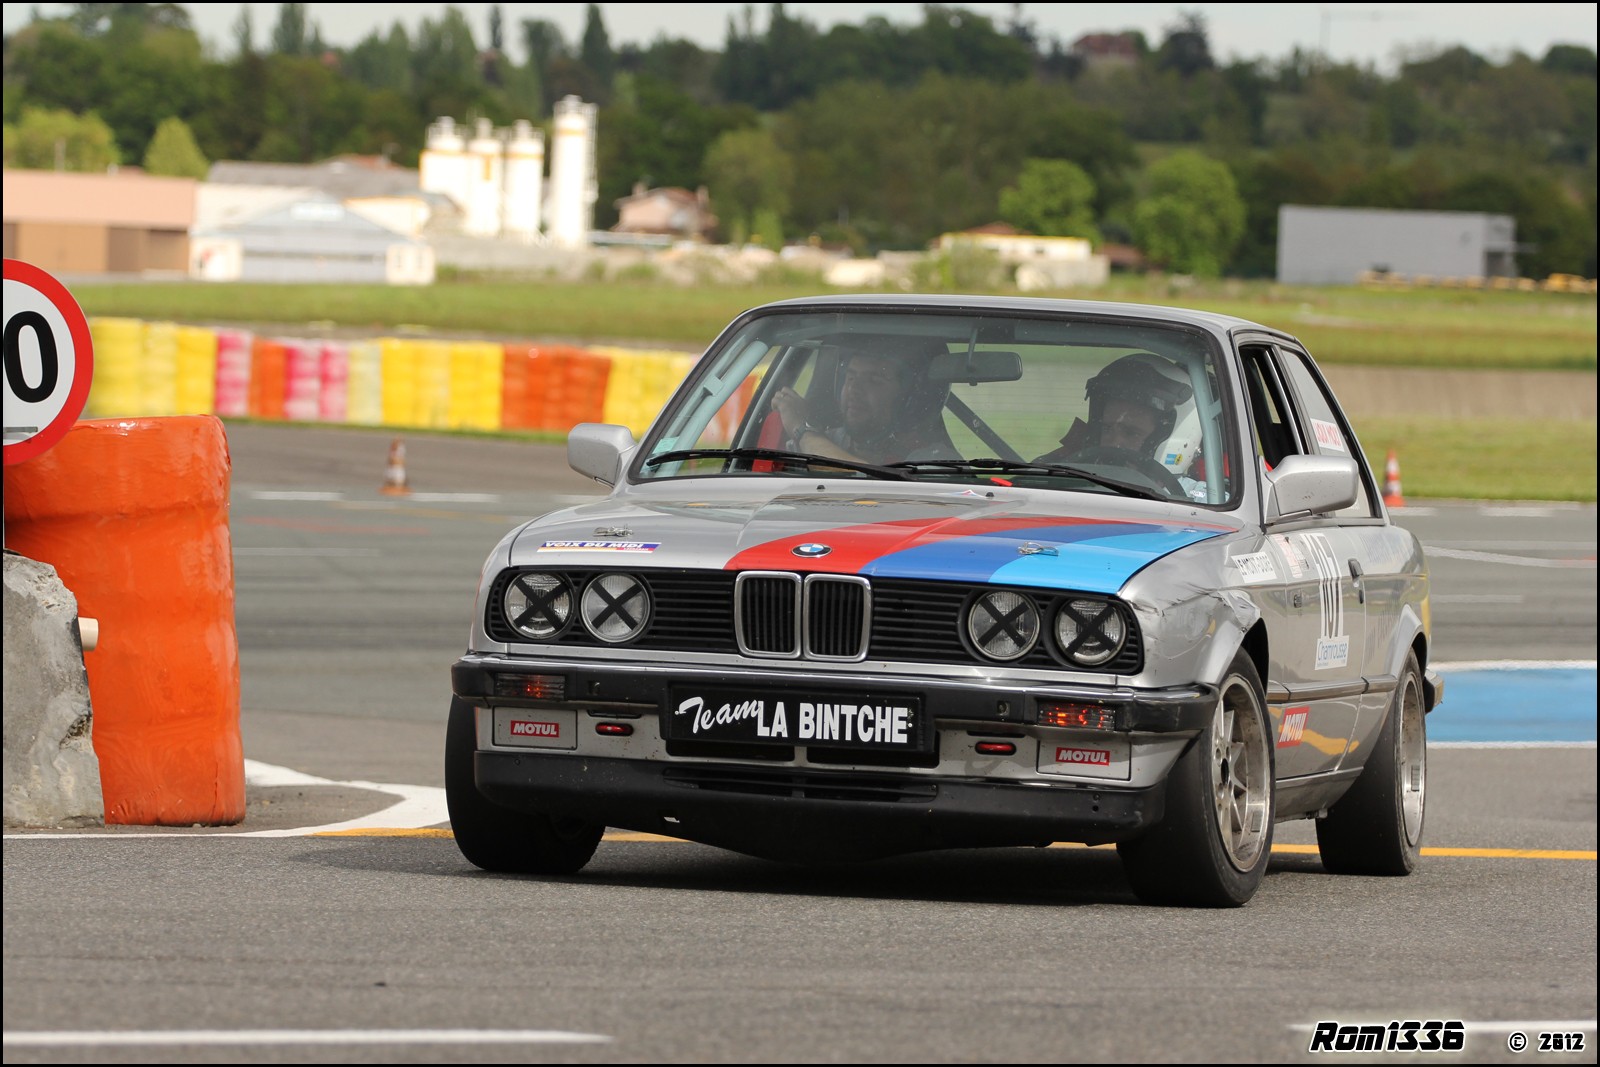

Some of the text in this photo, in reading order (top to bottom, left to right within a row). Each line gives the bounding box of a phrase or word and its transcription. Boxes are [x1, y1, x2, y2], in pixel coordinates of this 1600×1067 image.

[1317, 640, 1348, 661] Chamrousse
[513, 722, 557, 735] MOTUL
[678, 696, 908, 744] Team LA BINTCHE
[1279, 713, 1307, 743] MOTUL
[1059, 750, 1107, 763] MOTUL
